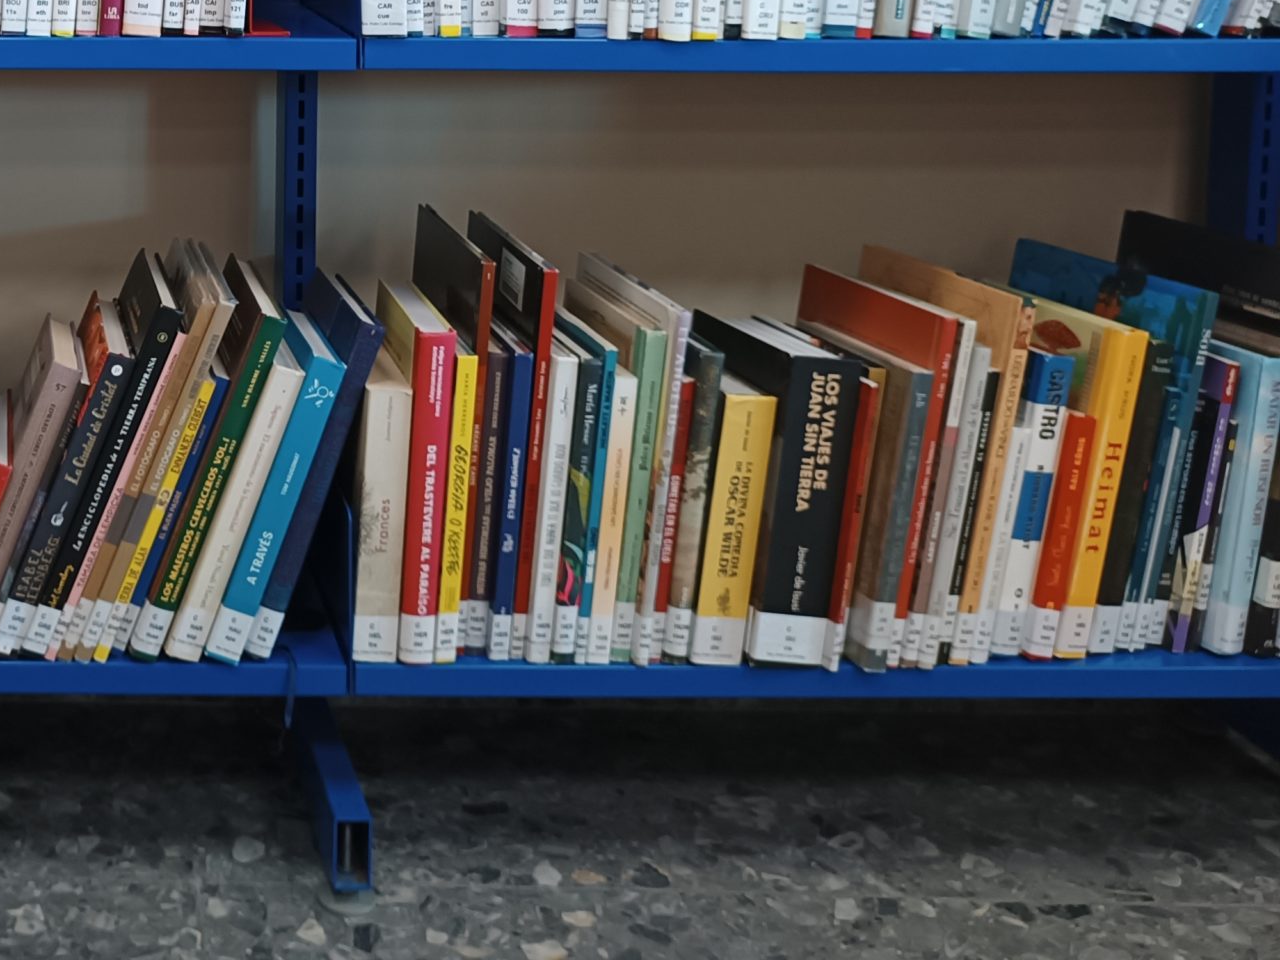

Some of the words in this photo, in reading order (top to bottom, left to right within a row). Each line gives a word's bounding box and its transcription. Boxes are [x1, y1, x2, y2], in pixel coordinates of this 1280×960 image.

[91, 379, 117, 419] Cristal
[807, 372, 825, 419] JUAN
[824, 373, 842, 407] LOS
[1038, 369, 1065, 441] CASTRO
[77, 462, 114, 539] ENCICLOPEDIA
[113, 437, 123, 450] LA
[120, 402, 138, 435] TIERRA
[133, 356, 157, 401] TEMPRANA
[88, 419, 102, 432] de
[803, 423, 819, 453] SIN
[816, 410, 837, 466] VIAJES
[71, 431, 96, 469] Ciudad
[426, 444, 437, 468] DEL
[454, 444, 469, 513] GEORGIA
[736, 476, 751, 519] DIVINA
[795, 457, 815, 513] TIERRA
[813, 470, 828, 491] DE
[1086, 441, 1123, 554] Heimat
[421, 470, 436, 544] TRASTEVERE
[665, 514, 676, 527] EN
[723, 476, 740, 528] OSCAR
[160, 581, 174, 601] LOS
[168, 528, 194, 580] MAESTROS
[188, 465, 218, 528] CERVECEROS
[375, 499, 391, 554] Frances
[246, 529, 273, 574] TRAVÉS
[420, 546, 431, 562] AL
[717, 532, 732, 578] WILDE
[729, 522, 744, 578] COMEDIA
[795, 545, 808, 575] Javier
[245, 574, 257, 585] A
[793, 576, 805, 589] de
